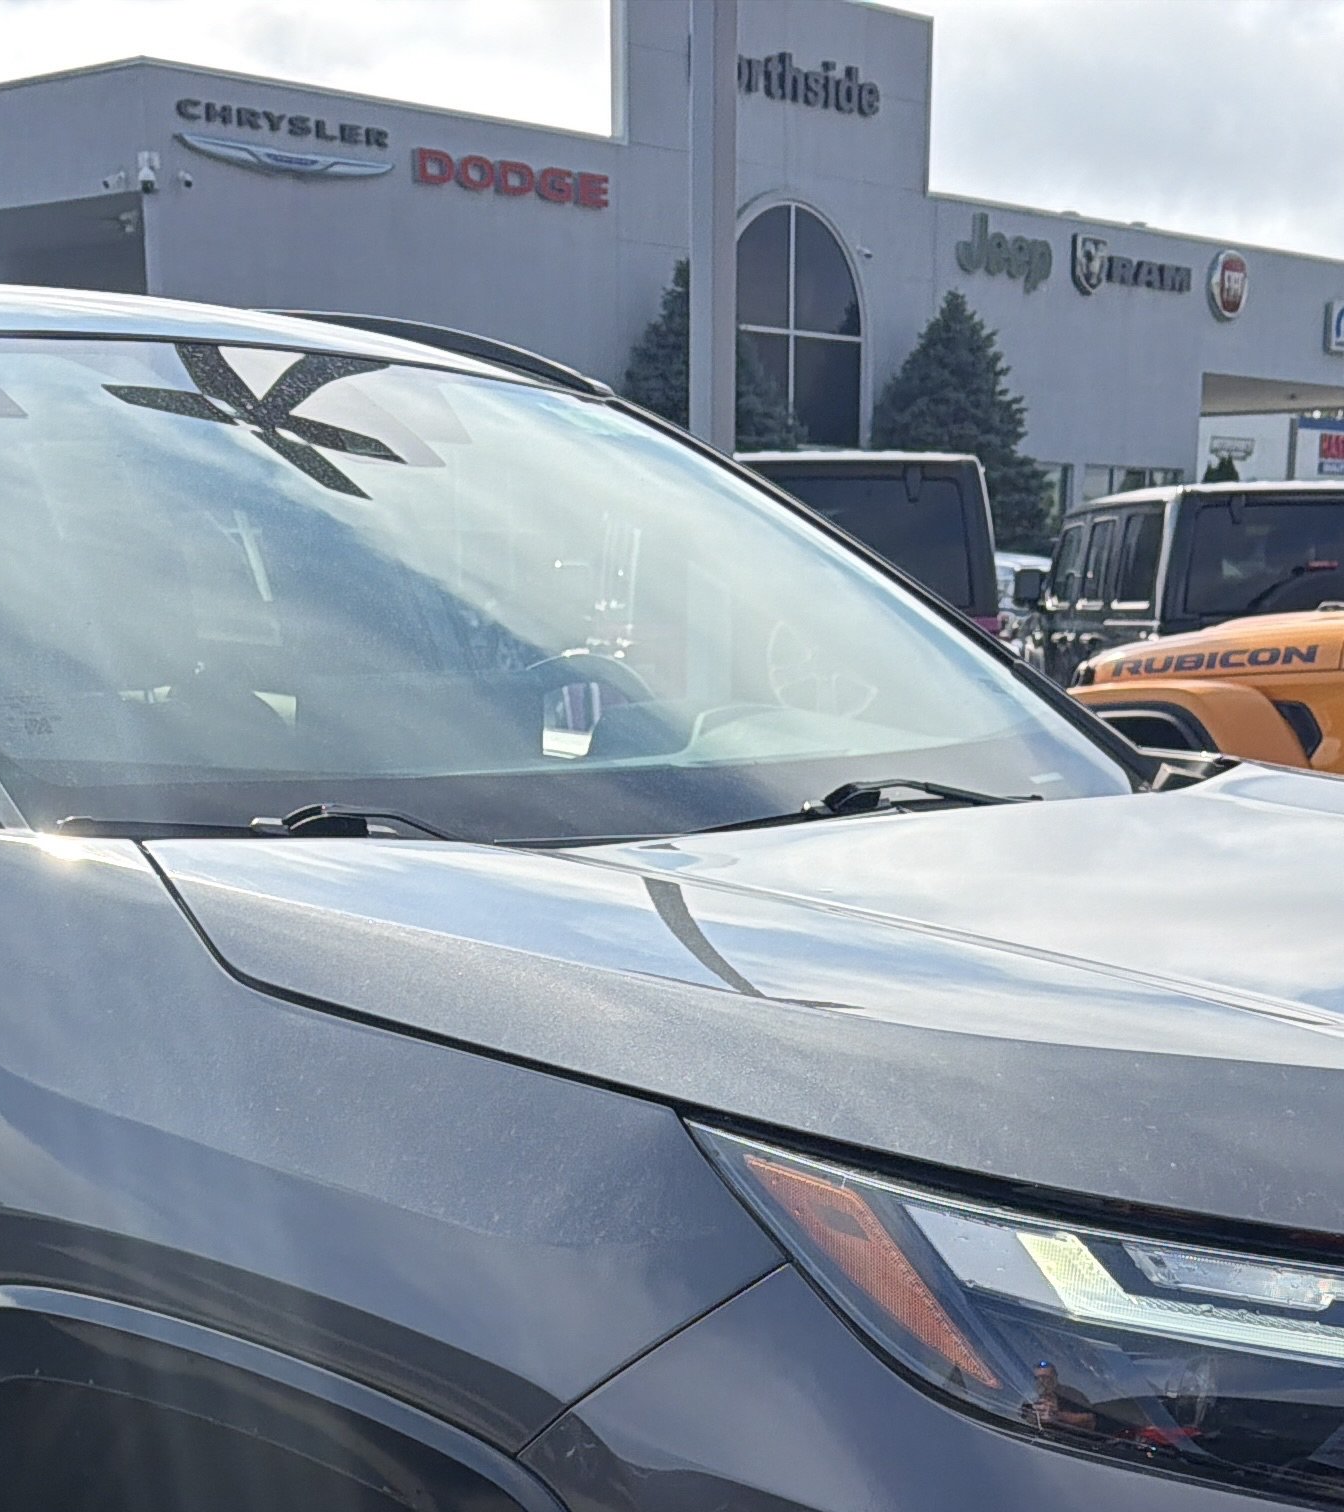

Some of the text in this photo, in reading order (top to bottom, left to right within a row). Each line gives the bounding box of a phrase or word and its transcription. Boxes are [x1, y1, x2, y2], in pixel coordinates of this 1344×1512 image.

[175, 98, 390, 148] CHRYSLER
[412, 146, 610, 209] DODGE
[956, 212, 1053, 295] Jeep
[1106, 255, 1193, 293] RAM
[1111, 644, 1319, 677] RUBICON
